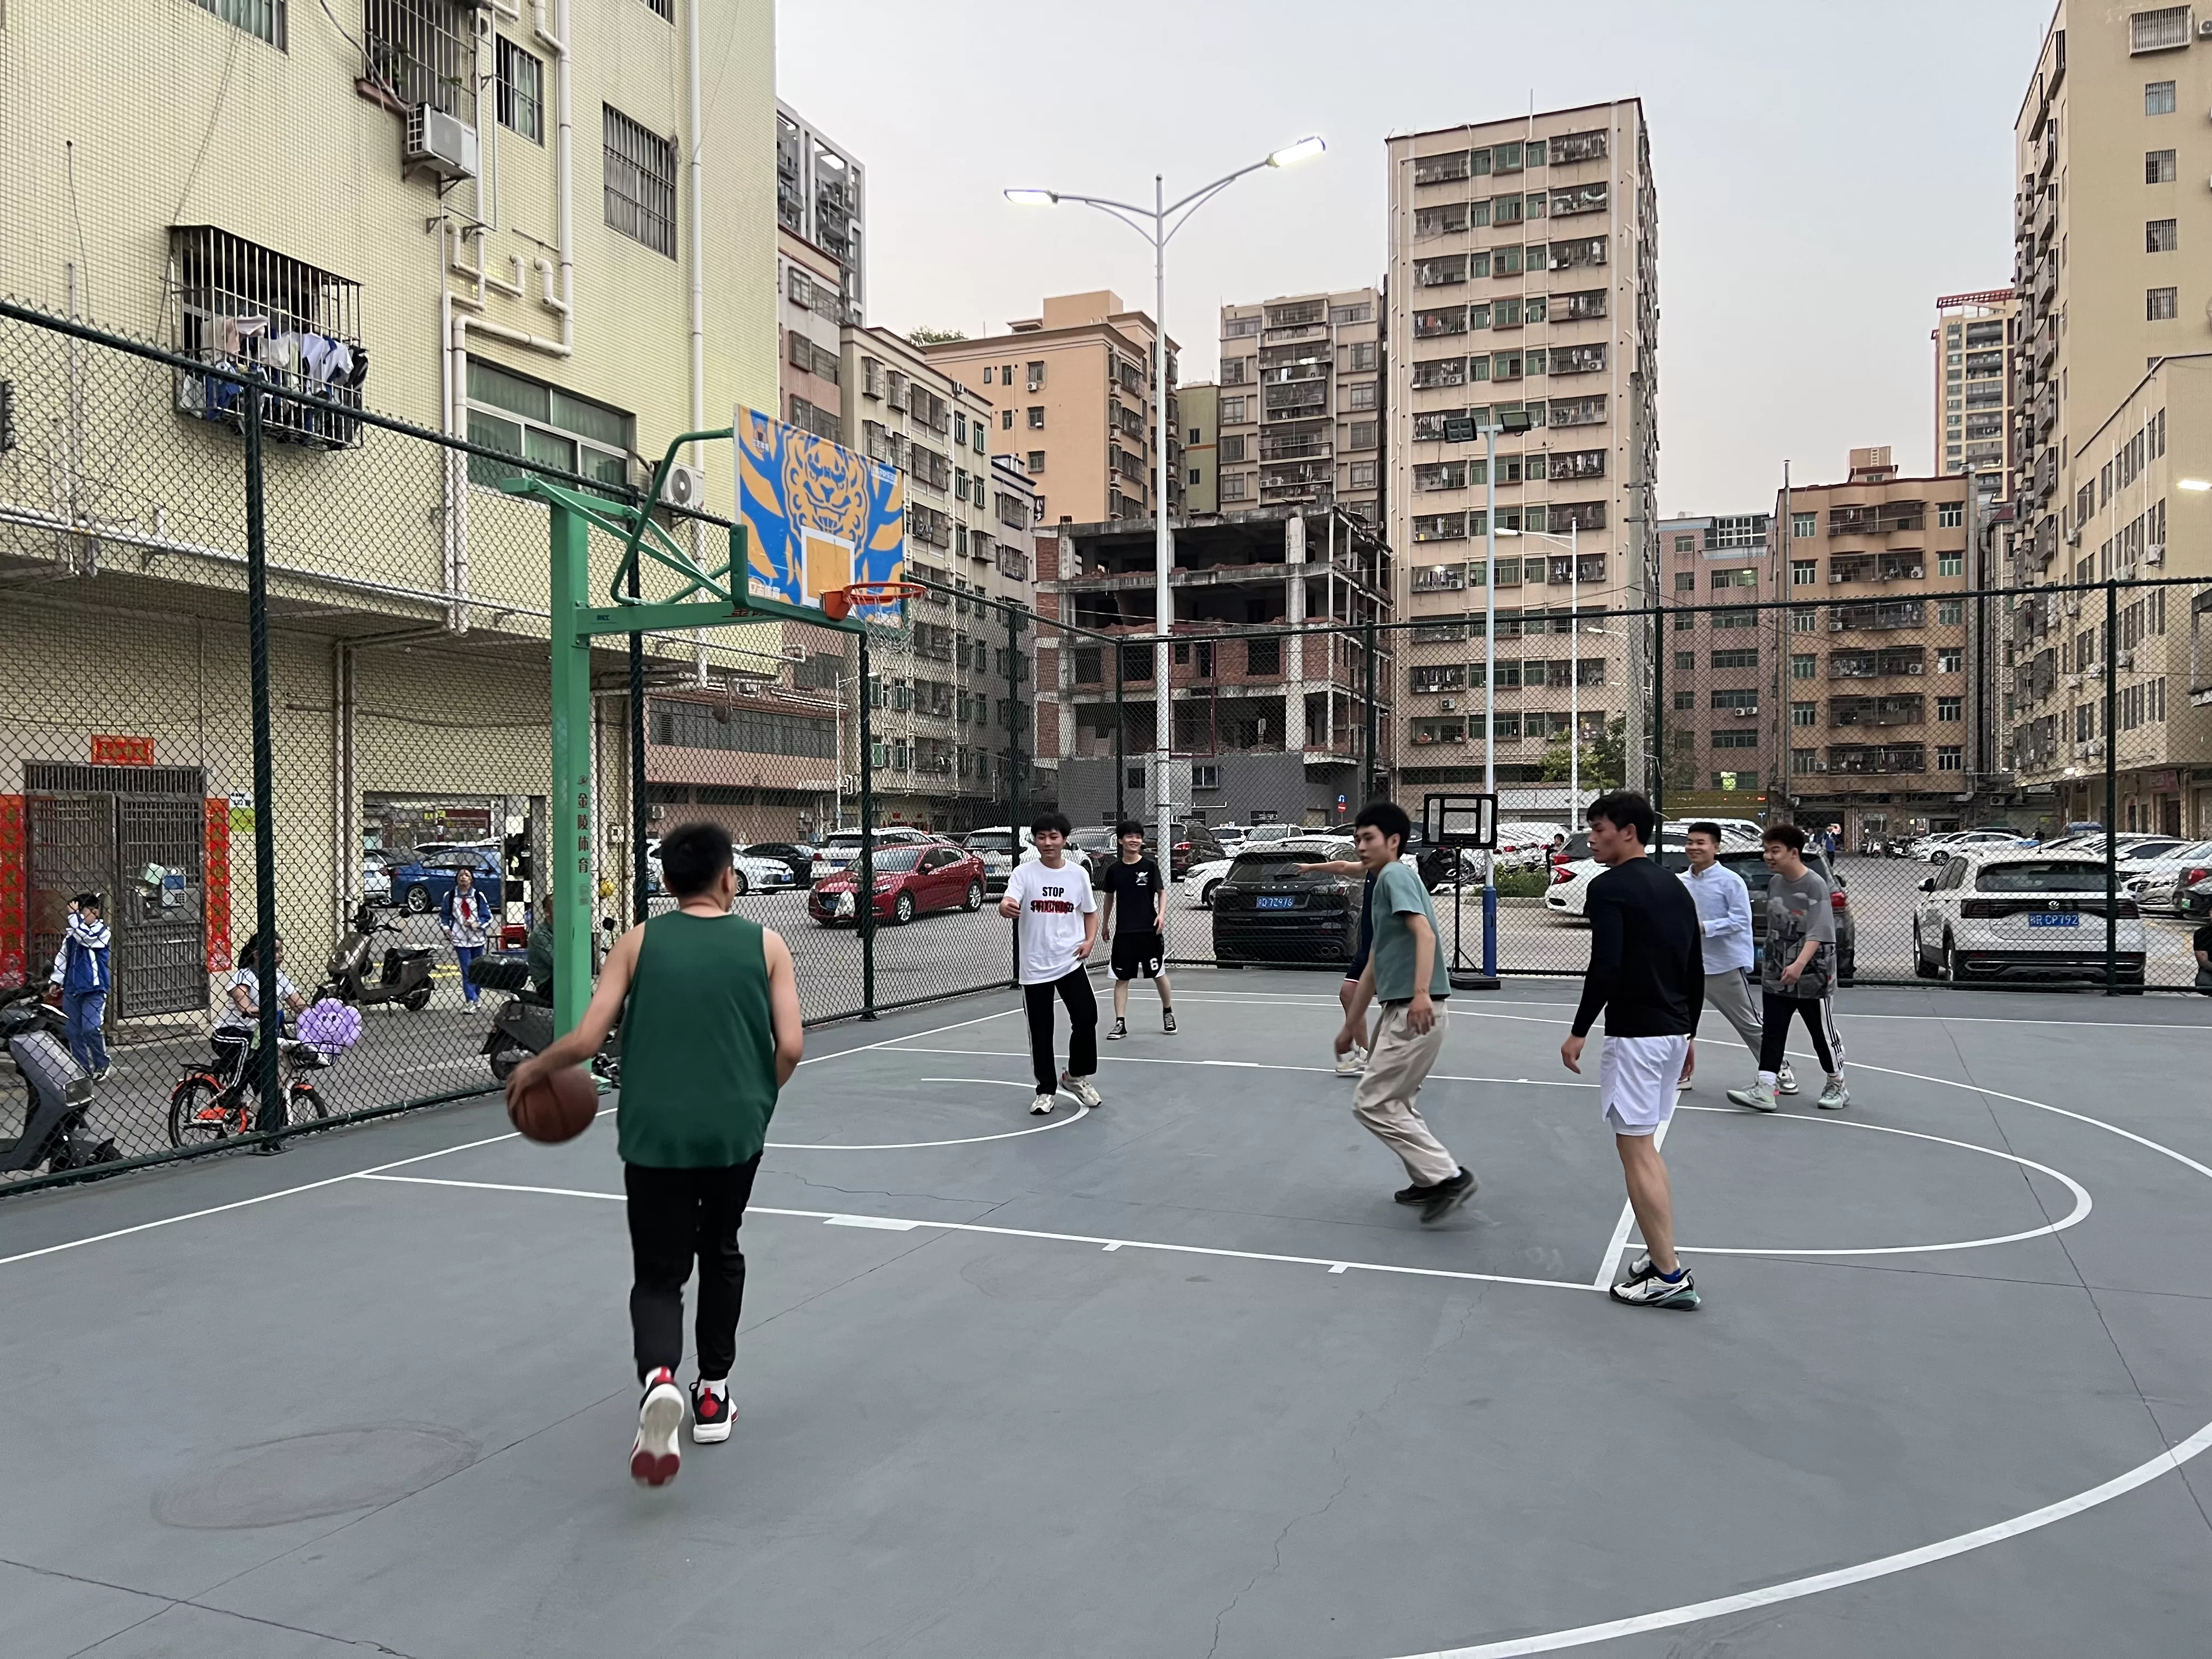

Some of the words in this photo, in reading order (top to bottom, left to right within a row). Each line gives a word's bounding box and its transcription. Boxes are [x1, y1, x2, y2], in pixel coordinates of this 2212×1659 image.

[578, 793, 589, 873] 金陵体育
[1042, 886, 1064, 898] STOP
[1149, 957, 1159, 970] 6
